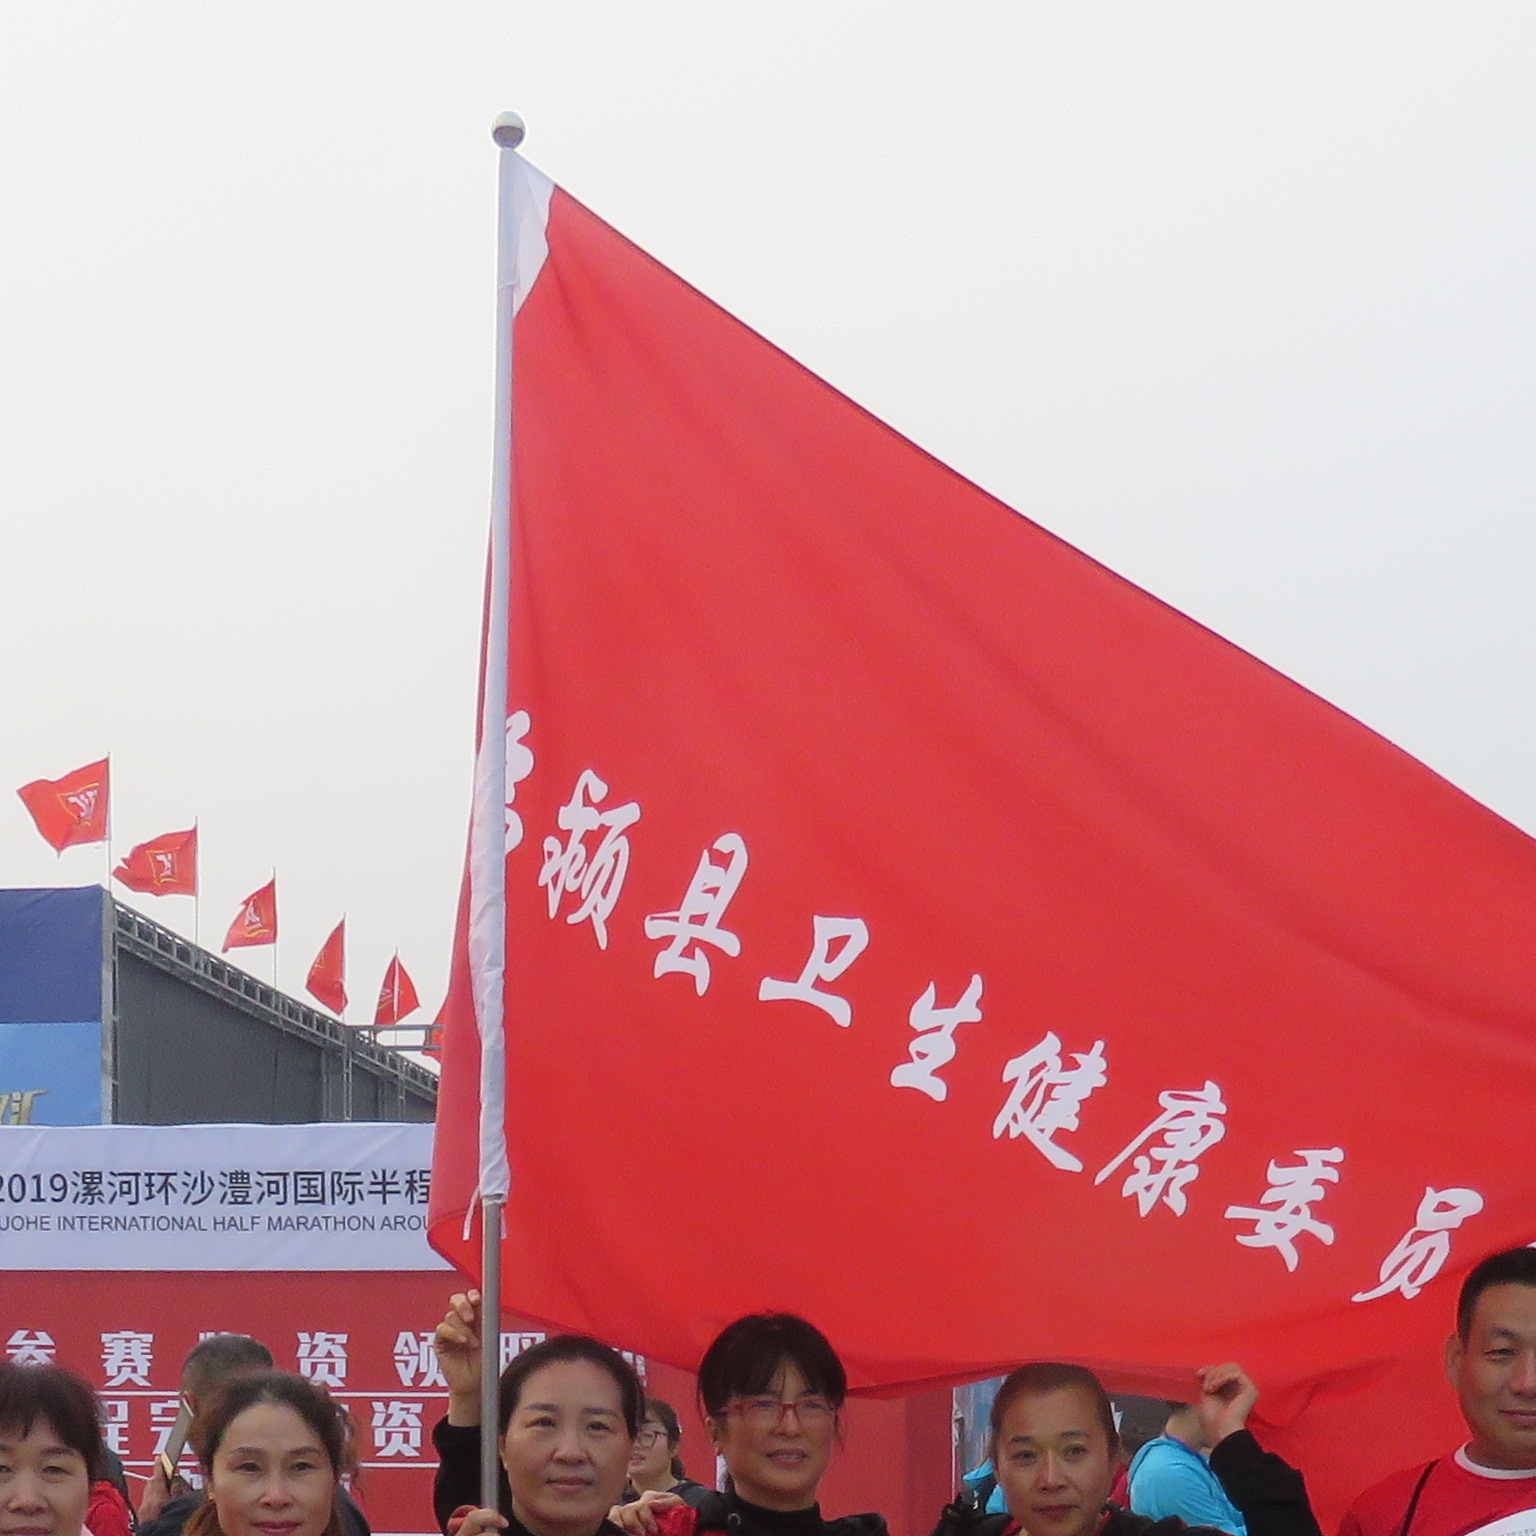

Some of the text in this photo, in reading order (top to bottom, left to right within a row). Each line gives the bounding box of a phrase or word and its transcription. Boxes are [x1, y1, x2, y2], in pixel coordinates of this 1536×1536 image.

[57, 1215, 208, 1232] INTERNATIONAL
[213, 1215, 261, 1231] HALF
[267, 1214, 375, 1231] MARATHON
